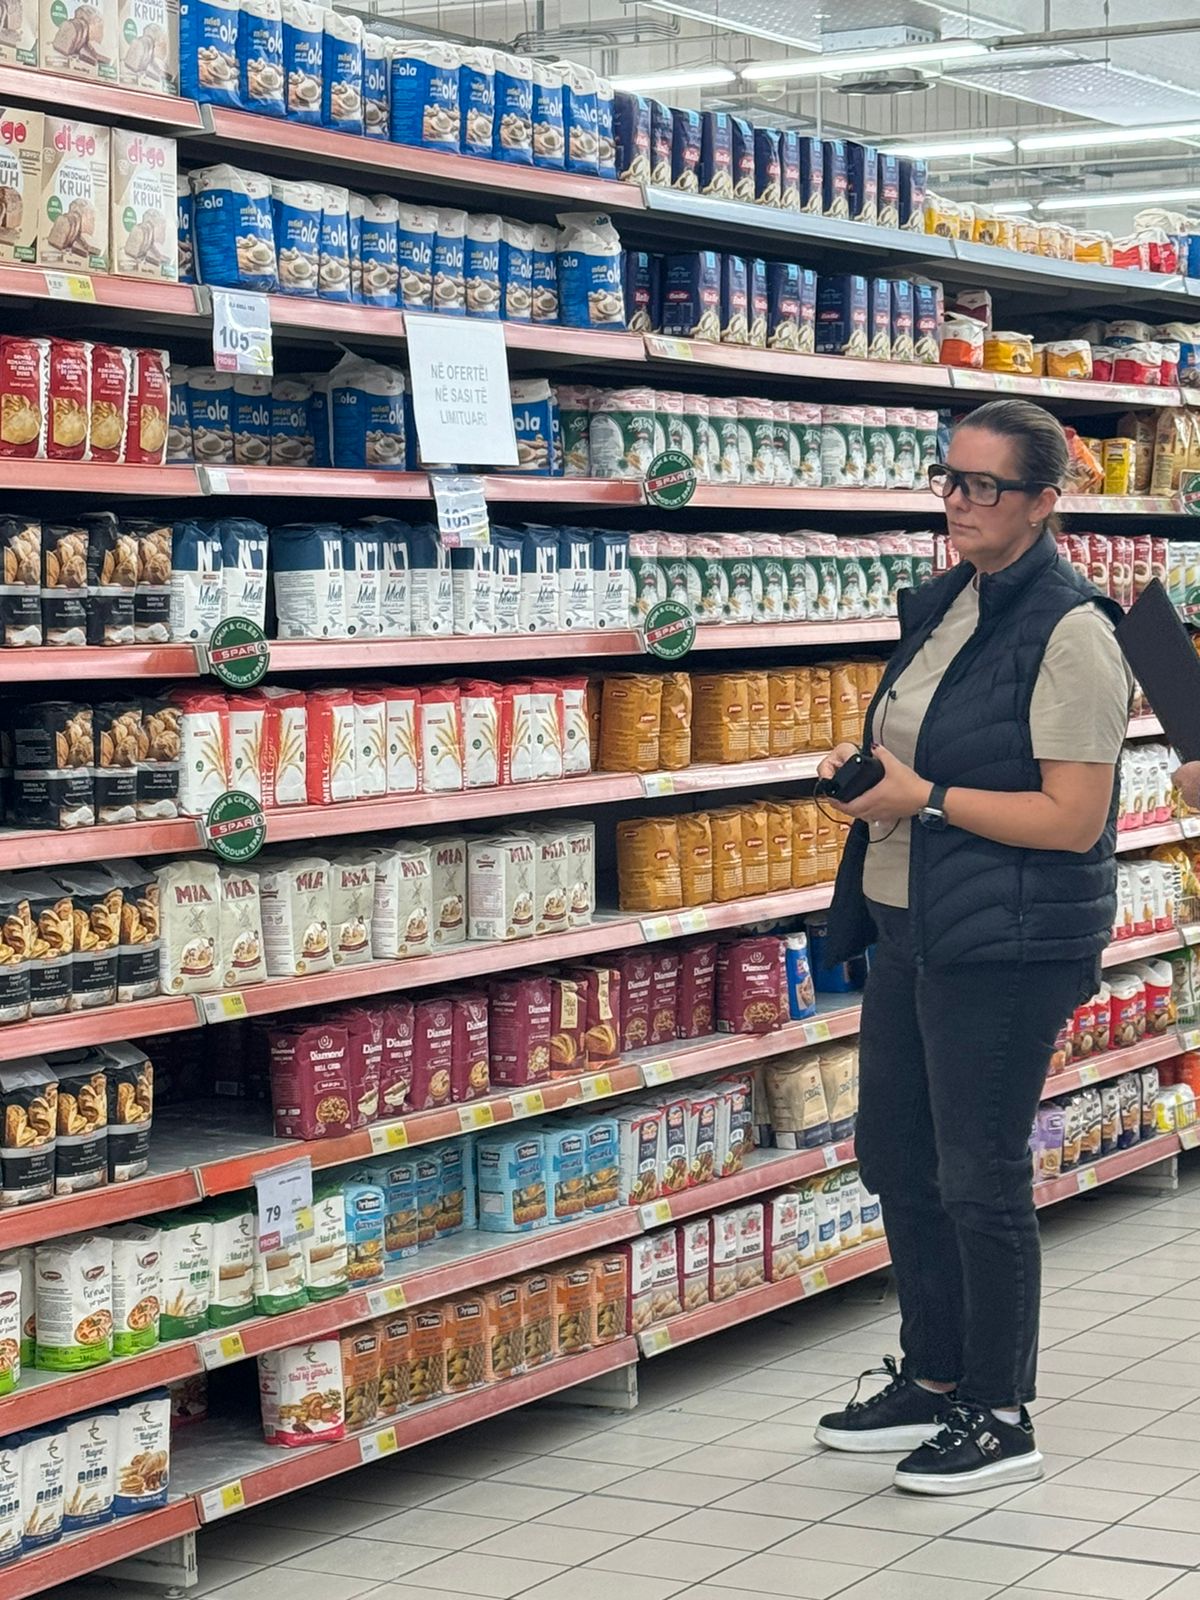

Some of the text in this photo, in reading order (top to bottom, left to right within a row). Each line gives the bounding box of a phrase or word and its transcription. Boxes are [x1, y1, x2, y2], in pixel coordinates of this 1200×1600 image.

[400, 63, 417, 76] ola
[369, 70, 385, 91] ola
[55, 124, 96, 157] di-go
[128, 138, 165, 170] di-go
[59, 182, 92, 199] KRUH
[133, 191, 162, 209] KRUH
[302, 220, 318, 243] ola
[331, 224, 347, 247] ola
[378, 232, 396, 253] ola
[413, 242, 430, 264] ola
[446, 247, 463, 268] ola
[483, 251, 499, 271] ola
[219, 326, 250, 351] 105
[431, 362, 489, 382] NË OFERTË!
[435, 385, 488, 404] NË SASI TË
[208, 399, 228, 421] ola
[253, 404, 269, 426] ola
[514, 411, 540, 432] ola
[221, 645, 255, 659] SPAR
[323, 767, 331, 803] MIELL
[219, 819, 253, 834] SPAR
[510, 845, 534, 862] MIA
[541, 842, 567, 861] MIA
[570, 837, 592, 854] MIA
[436, 848, 463, 866] MIA
[341, 868, 370, 887] MIA
[402, 860, 427, 878] MIA
[223, 879, 255, 899] MIA
[295, 872, 324, 891] MIA
[174, 884, 212, 904] MIA
[654, 968, 678, 980] Diamond
[310, 1047, 345, 1061] Diamond
[266, 1205, 281, 1223] 79
[260, 1235, 280, 1249] PROMO
[83, 1286, 104, 1299] Farina
